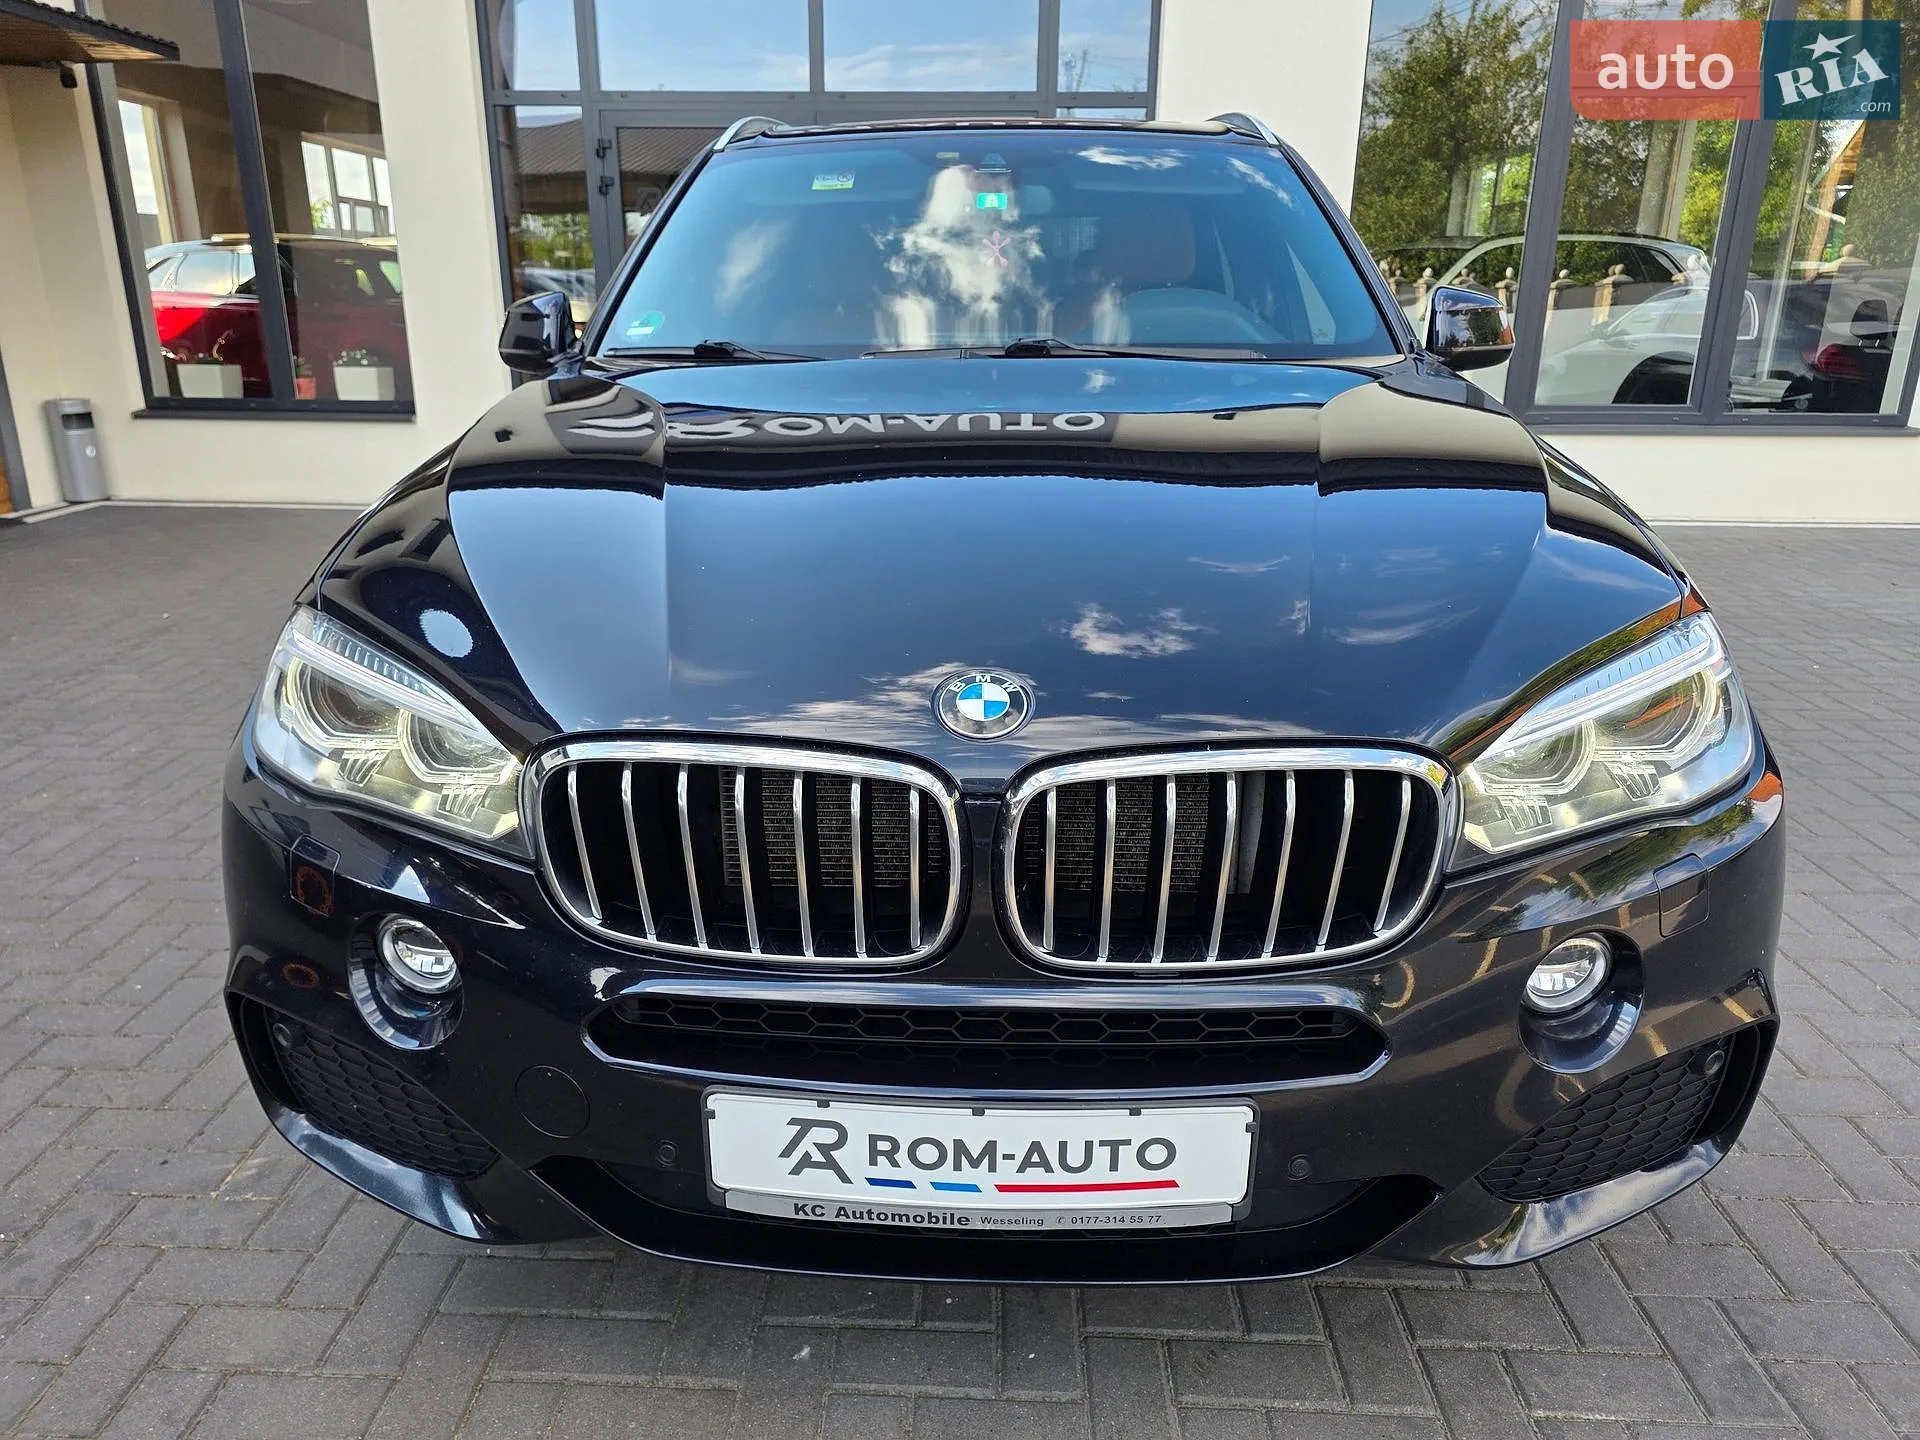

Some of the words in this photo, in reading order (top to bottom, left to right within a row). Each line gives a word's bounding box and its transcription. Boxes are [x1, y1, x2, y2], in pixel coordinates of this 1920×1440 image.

[949, 675, 1019, 692] BMW
[868, 1134, 1177, 1174] ROM-AUTO
[793, 1203, 826, 1217] KC
[835, 1206, 970, 1226] Automobile
[980, 1216, 1044, 1226] Wesseling
[1071, 1215, 1125, 1225] 0177-314
[1130, 1215, 1143, 1224] 55
[1148, 1215, 1161, 1224] 77
